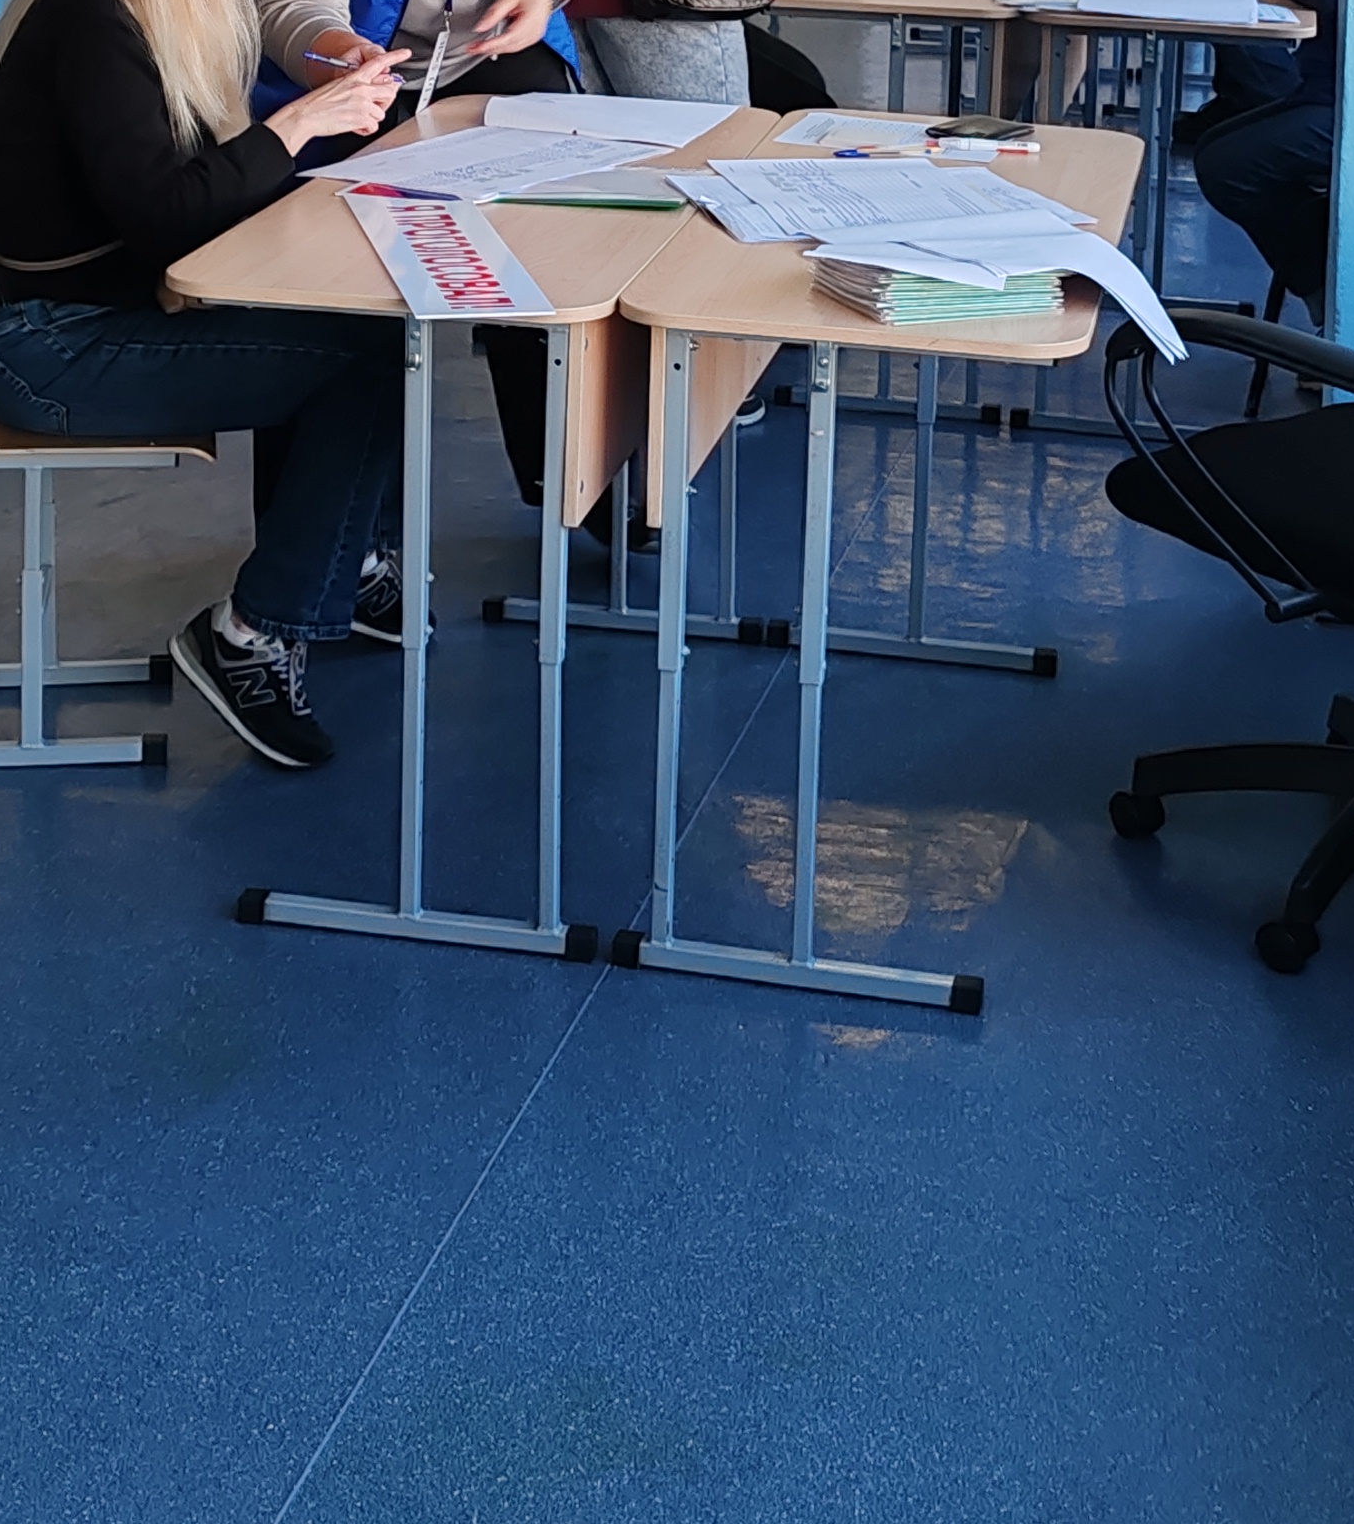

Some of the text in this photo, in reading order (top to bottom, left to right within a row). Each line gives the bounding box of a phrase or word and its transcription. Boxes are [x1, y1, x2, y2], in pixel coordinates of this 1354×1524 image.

[386, 204, 516, 310] Я ПРОГОЛОСОВАЛ!
[358, 580, 399, 618] N
[226, 667, 277, 709] N
